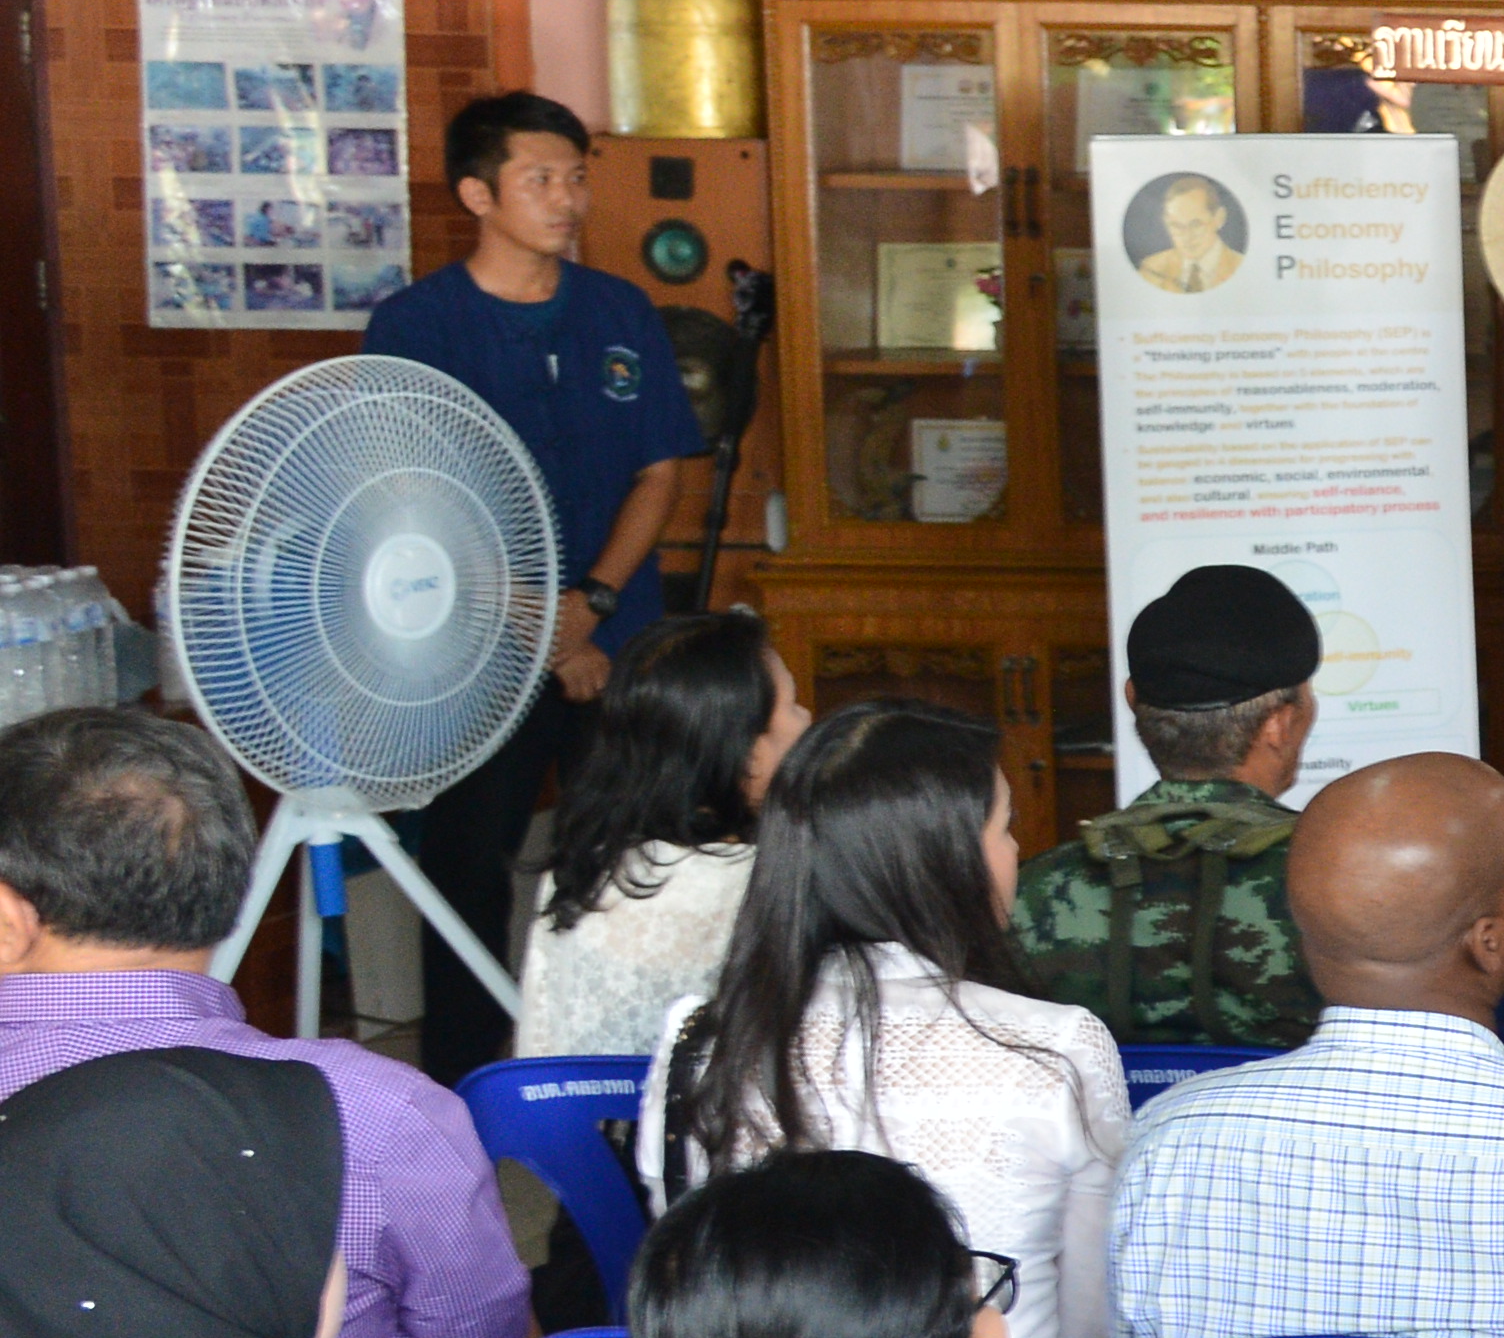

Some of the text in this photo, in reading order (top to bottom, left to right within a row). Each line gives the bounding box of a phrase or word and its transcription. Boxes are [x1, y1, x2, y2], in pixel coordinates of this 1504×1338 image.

[1273, 174, 1429, 204] Sufficiency
[1275, 214, 1404, 243] Economy
[1276, 255, 1429, 284] Philosophy
[1253, 541, 1338, 555] Middle Path
[1347, 699, 1399, 712] Virtues
